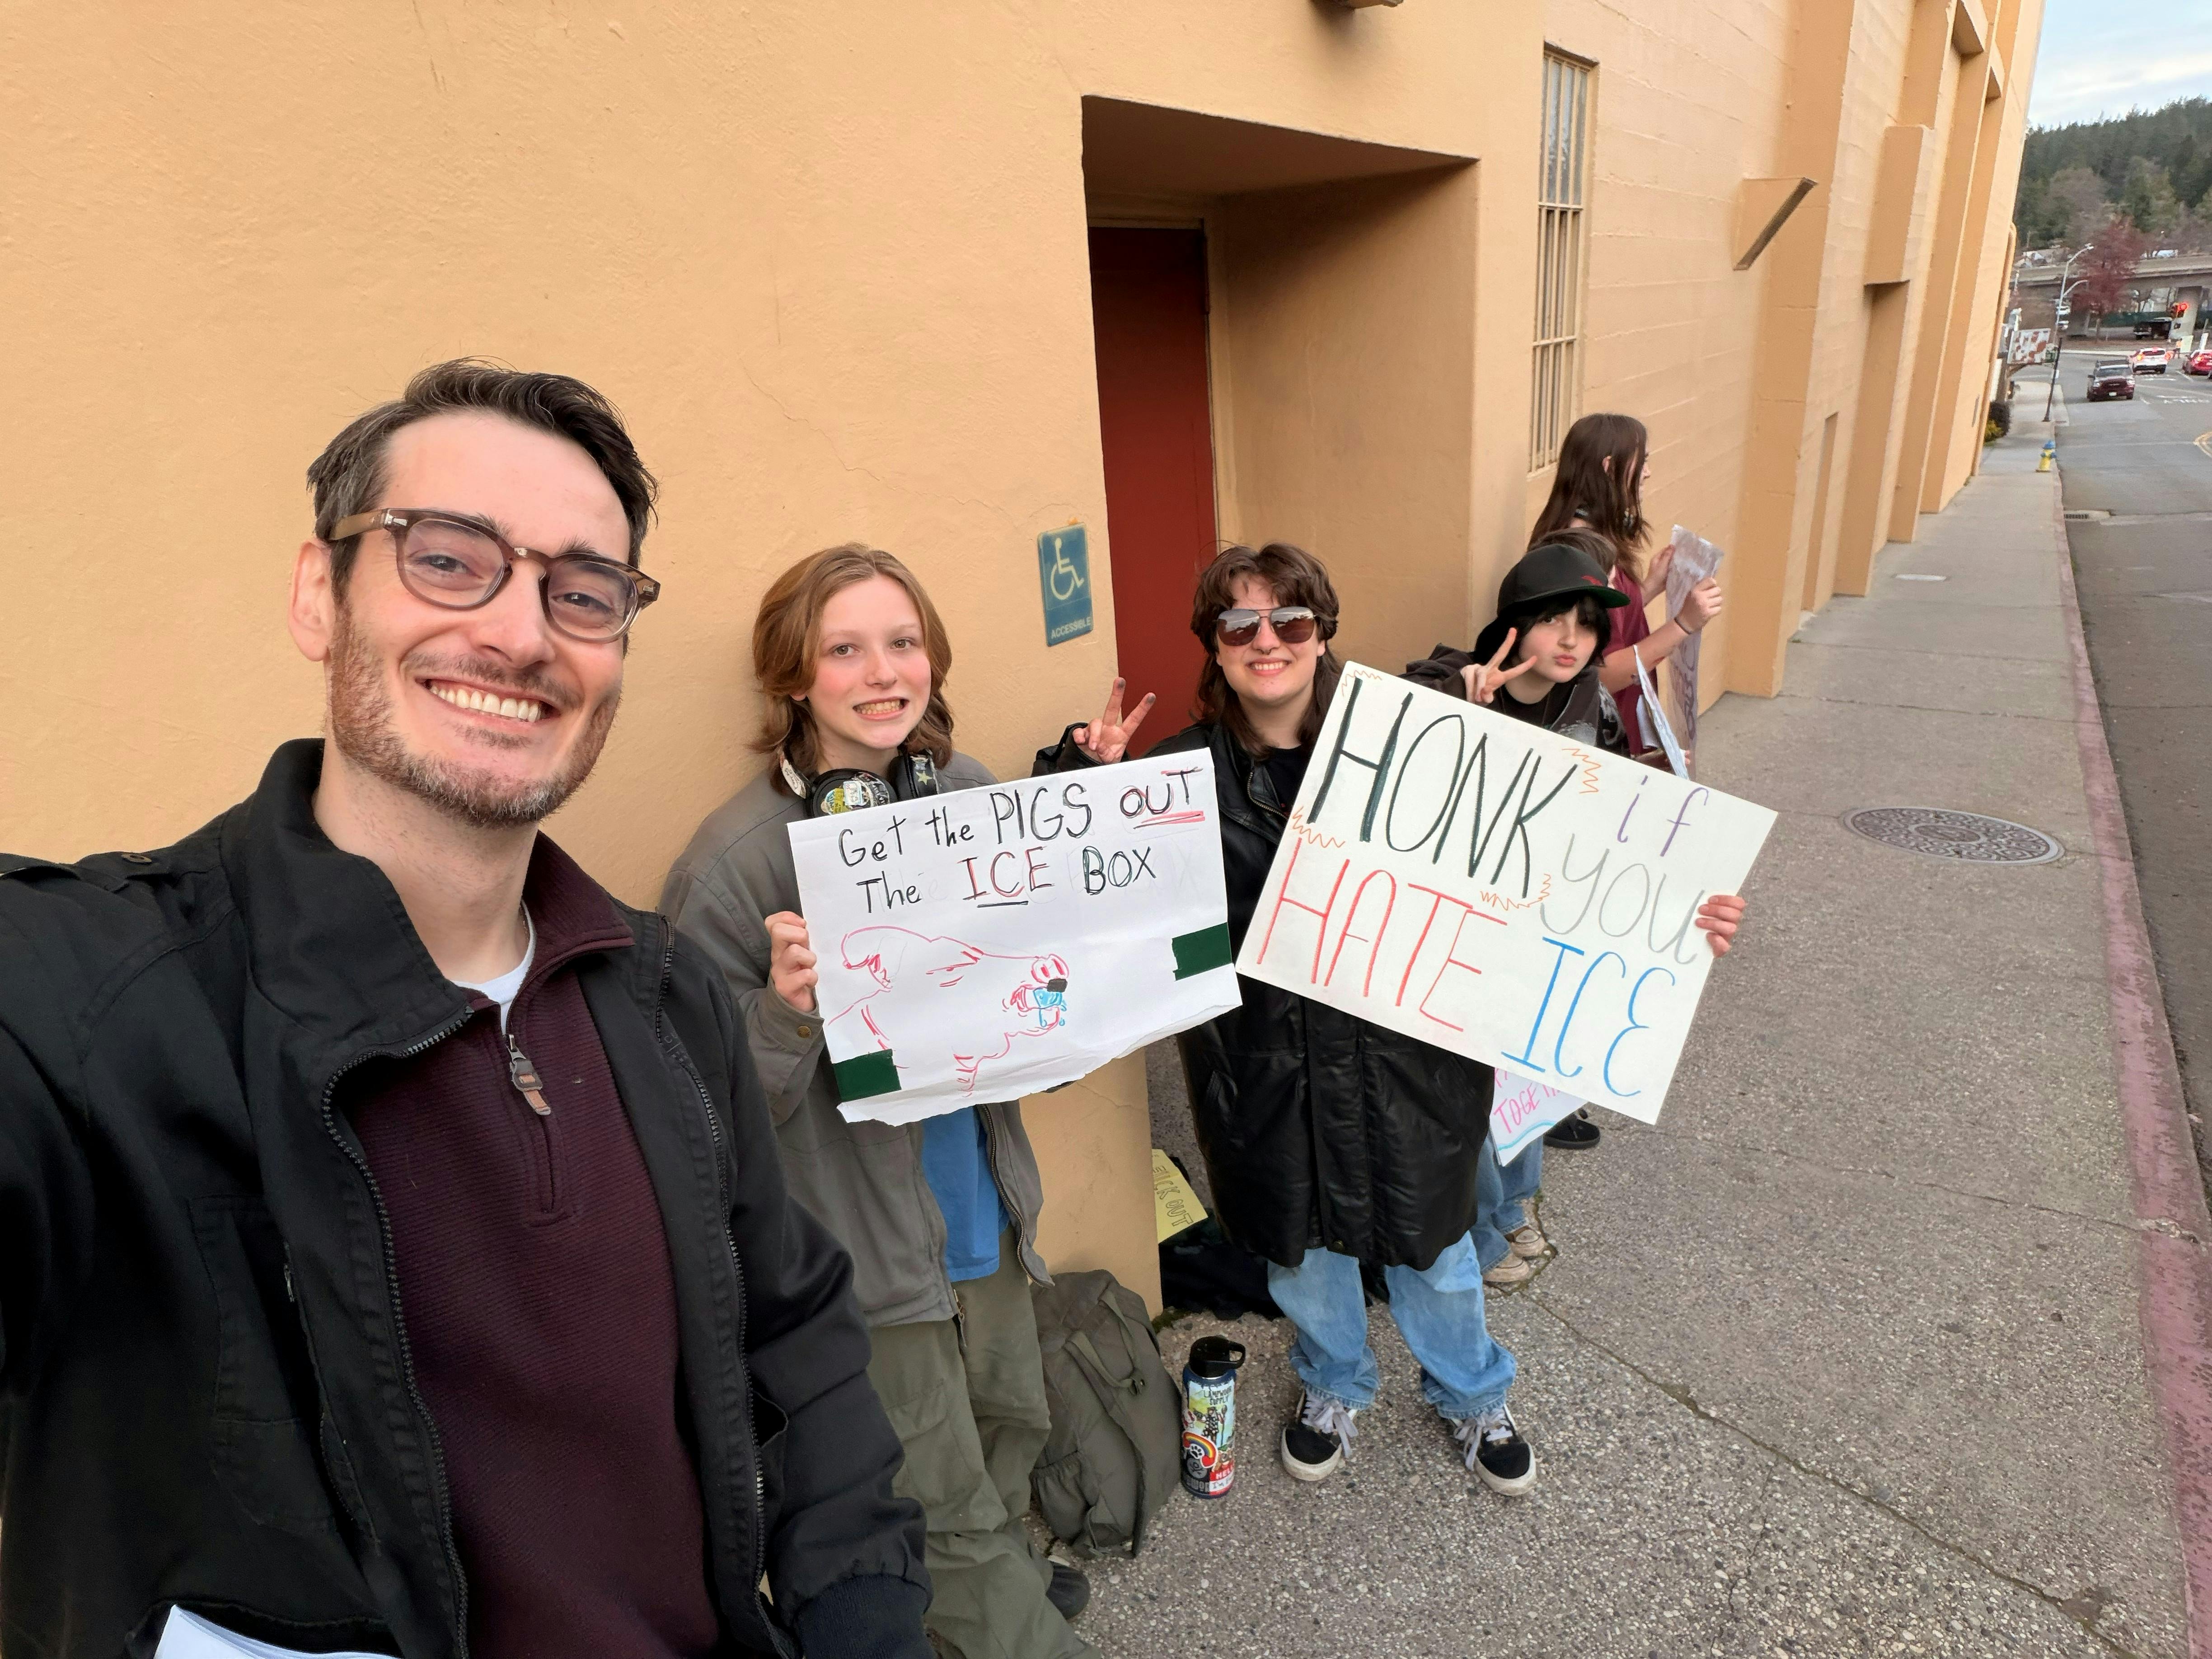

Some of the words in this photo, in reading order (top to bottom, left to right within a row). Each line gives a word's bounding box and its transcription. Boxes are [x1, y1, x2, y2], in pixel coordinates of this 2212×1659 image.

[1051, 616, 1091, 639] ACCESSIBLE
[839, 815, 907, 867] Get
[926, 808, 974, 848] the
[989, 783, 1092, 844] PIGS
[1120, 767, 1203, 818] OUT
[1307, 678, 1577, 899] HONK
[1617, 776, 1709, 857] if
[857, 871, 921, 914] The
[958, 846, 1054, 901] ICE
[1083, 846, 1157, 896] BOX
[1257, 838, 1507, 1032] HATE
[1501, 937, 1676, 1097] ICE
[1166, 1199, 1194, 1227] OUT
